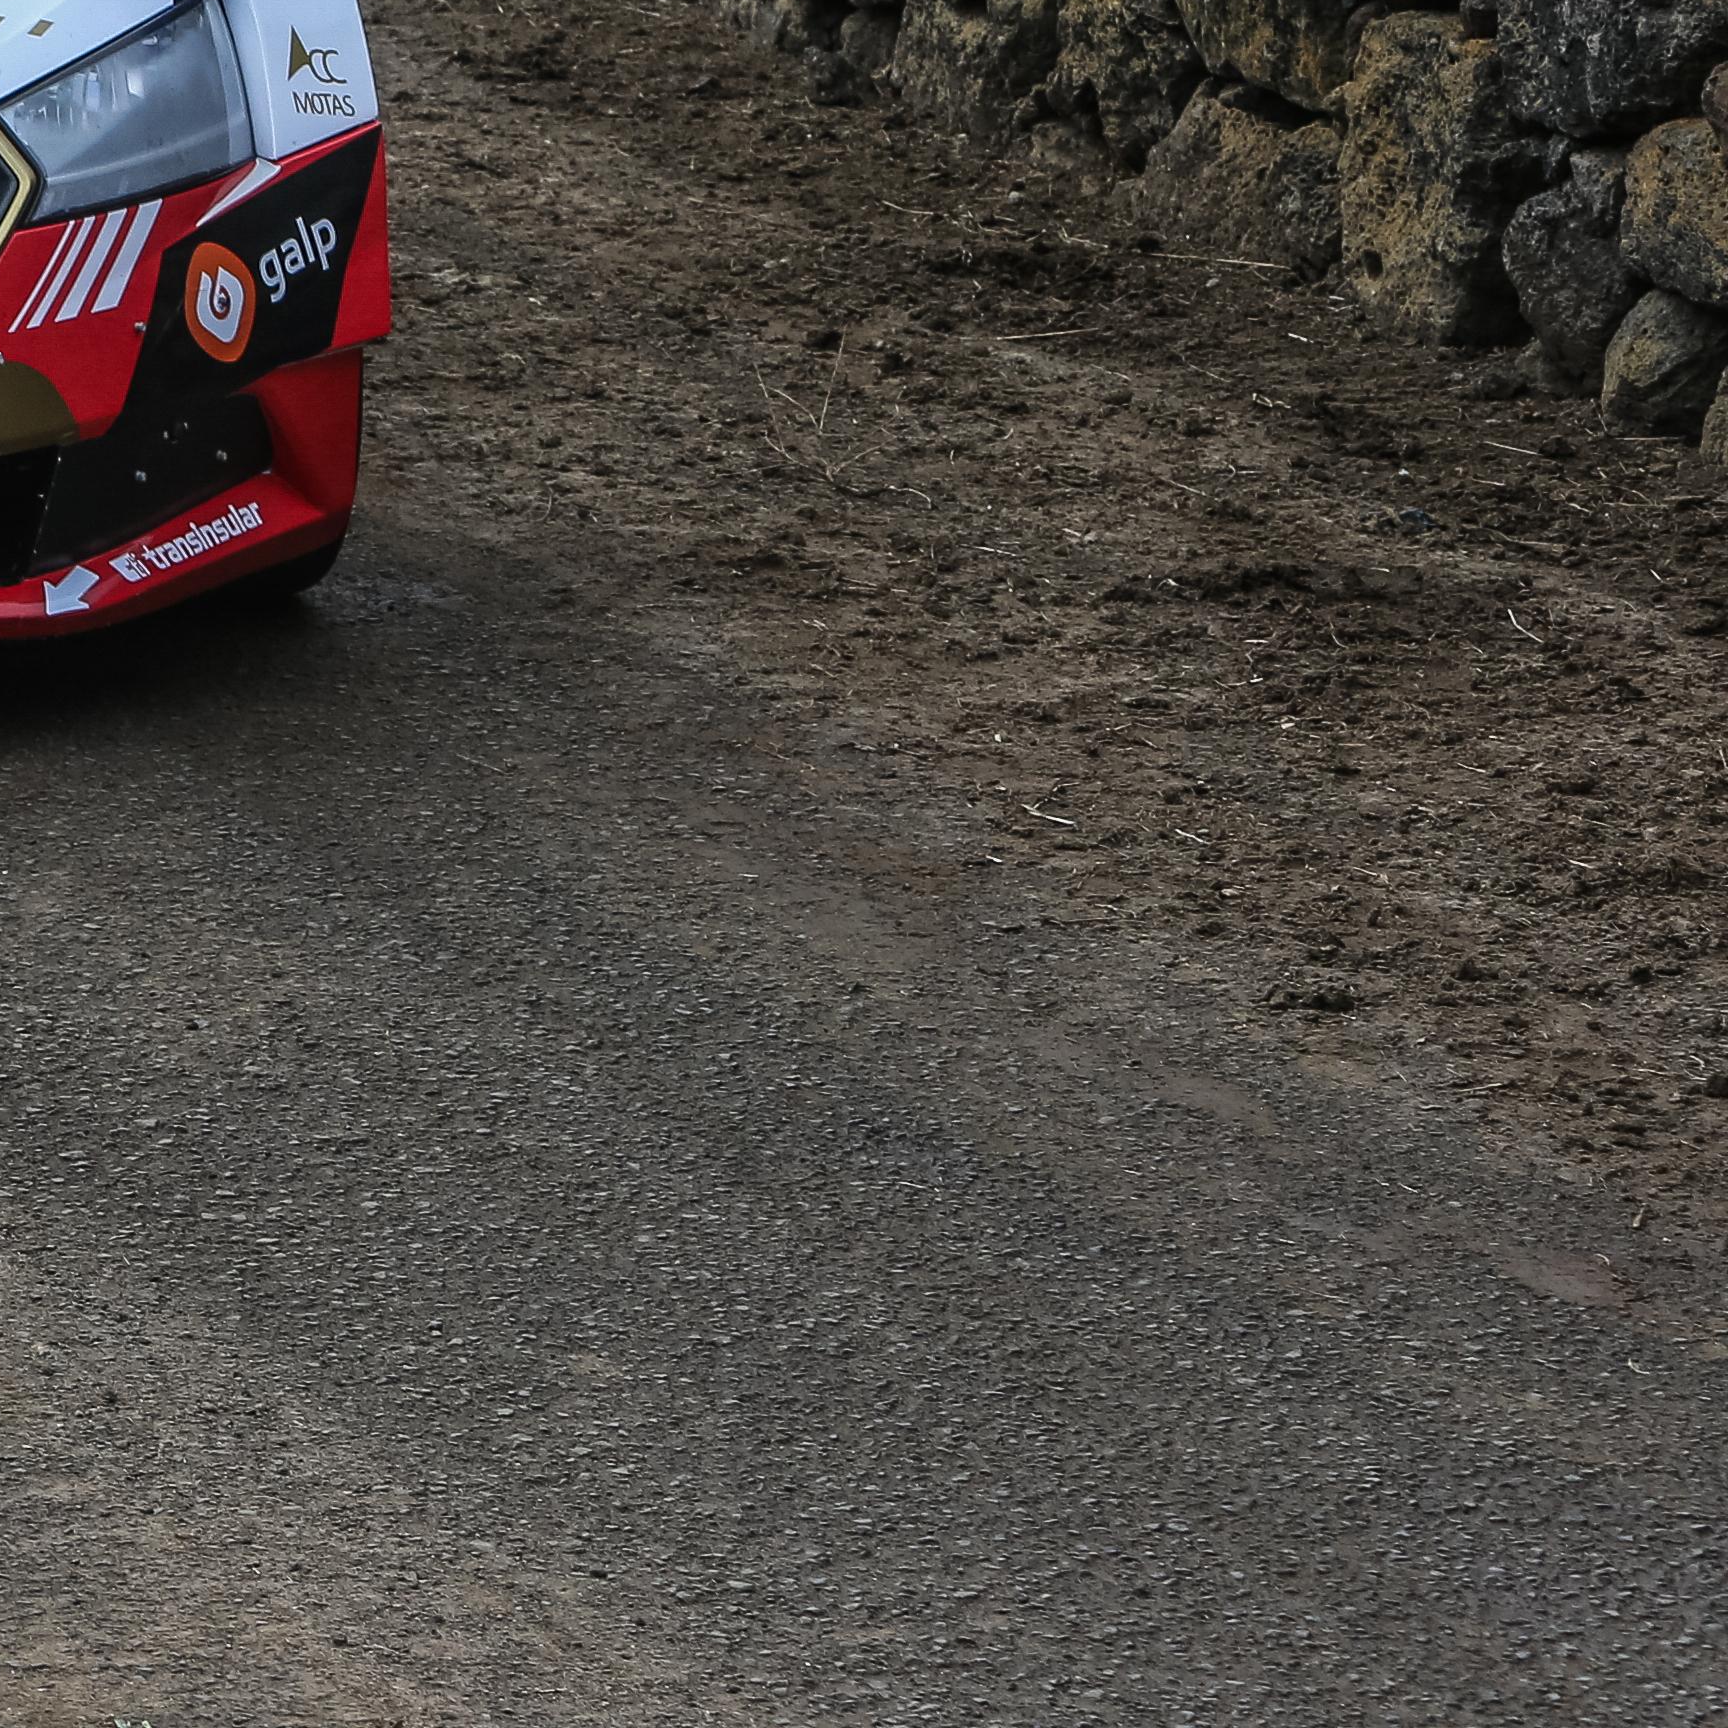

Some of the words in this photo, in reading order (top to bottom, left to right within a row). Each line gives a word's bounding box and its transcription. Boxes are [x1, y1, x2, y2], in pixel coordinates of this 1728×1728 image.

[292, 91, 356, 116] MOTAS
[258, 216, 337, 304] galp
[141, 501, 263, 570] transinsular
